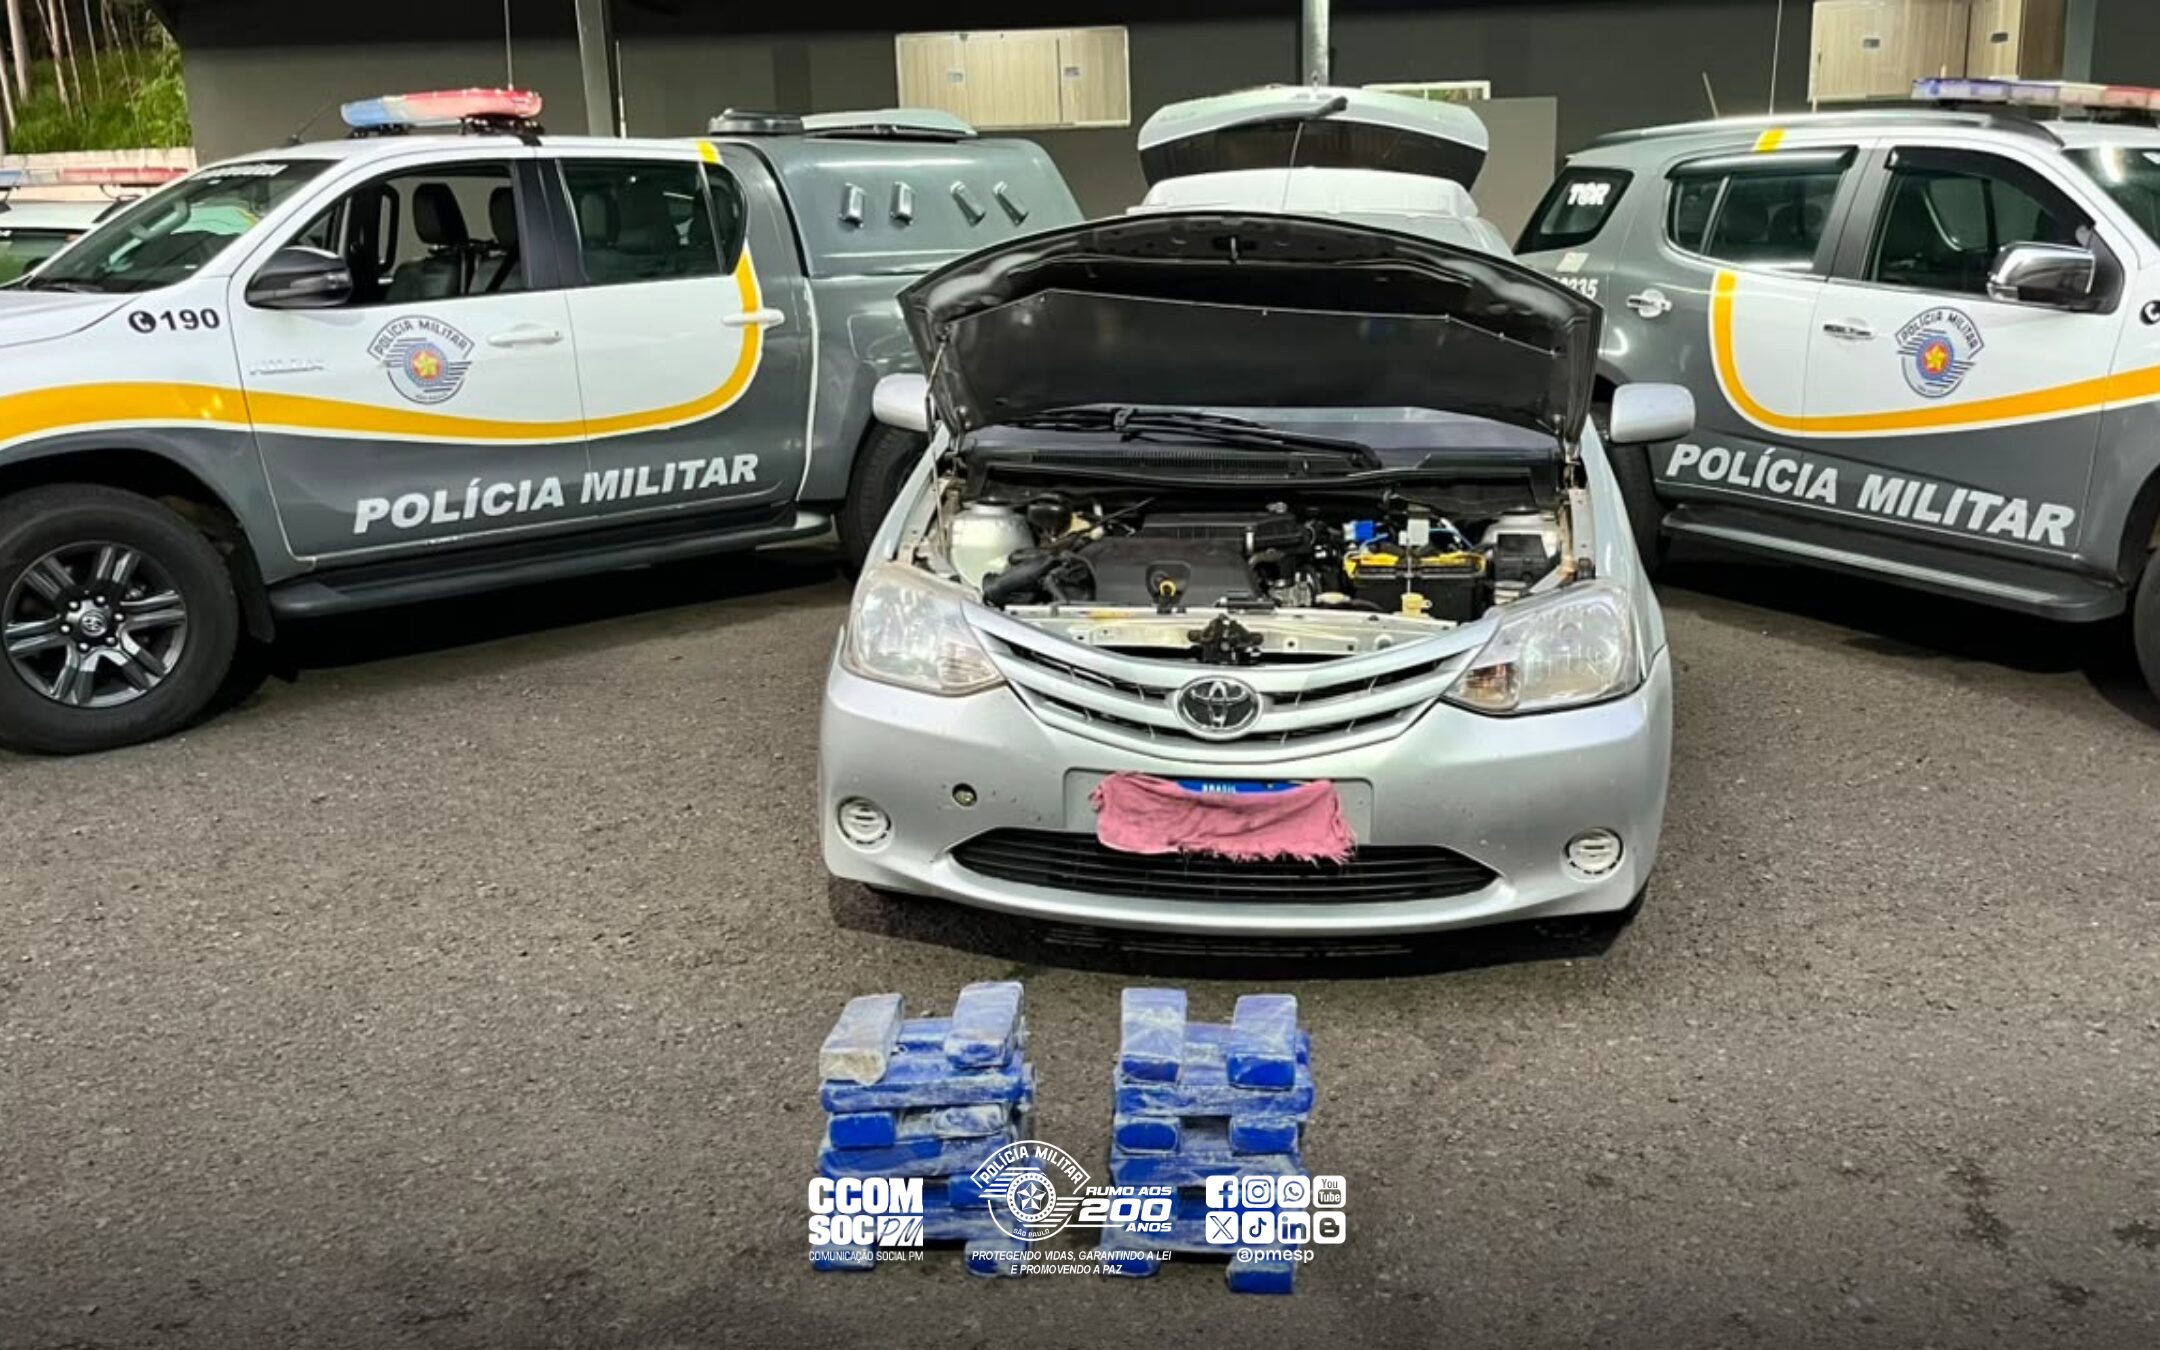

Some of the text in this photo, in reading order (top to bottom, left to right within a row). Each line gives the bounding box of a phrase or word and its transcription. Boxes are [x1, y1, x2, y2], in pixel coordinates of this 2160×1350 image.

[160, 308, 221, 331] 190
[419, 319, 468, 351] MILITAR
[353, 453, 759, 534] POLÍCIA MILITAR
[1665, 447, 2077, 546] POLÍCIA MILITAR
